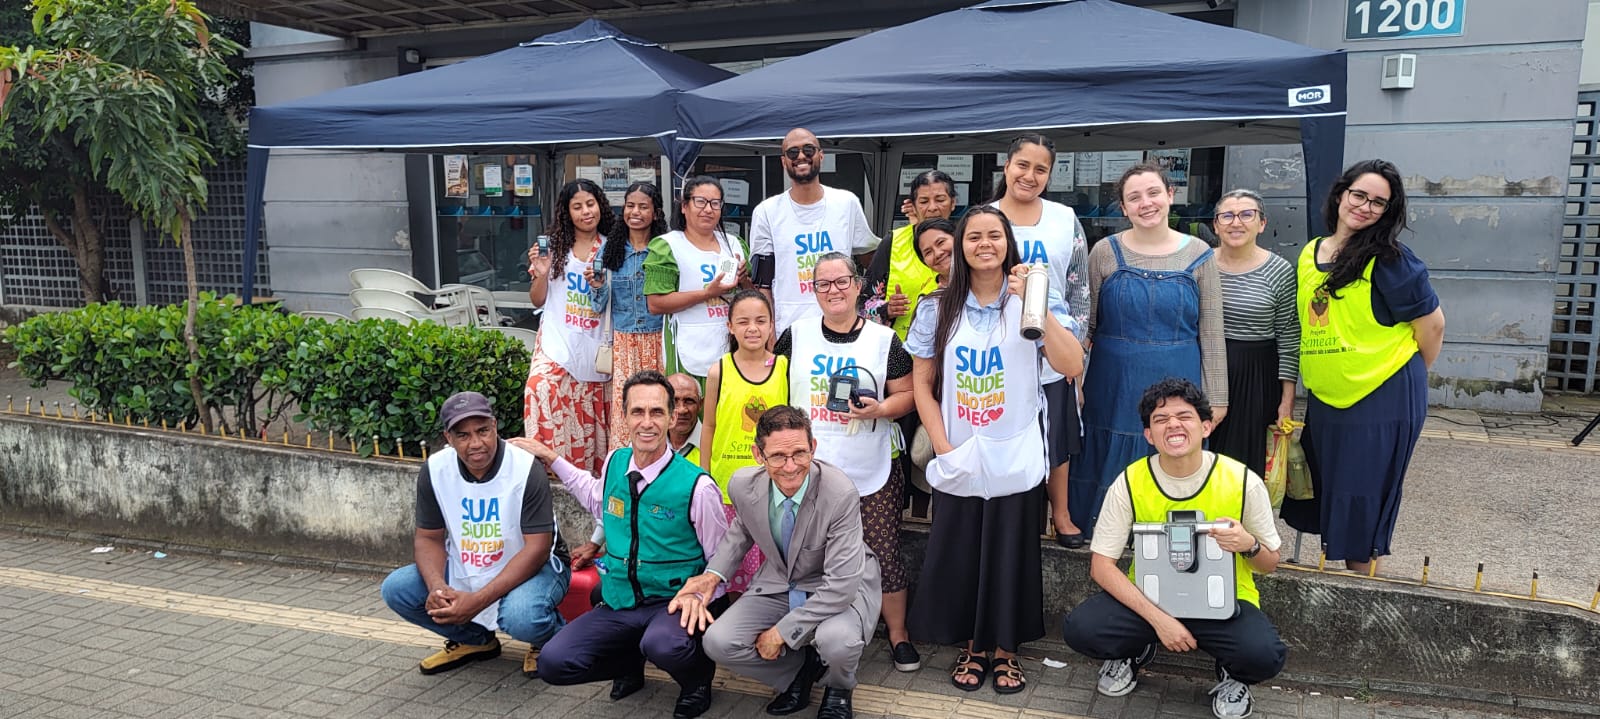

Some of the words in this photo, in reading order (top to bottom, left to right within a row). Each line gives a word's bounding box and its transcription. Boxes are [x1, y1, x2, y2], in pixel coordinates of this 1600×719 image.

[1355, 0, 1456, 34] 1200
[1298, 91, 1322, 101] MOR
[795, 231, 834, 255] SUA
[567, 271, 591, 294] SU
[810, 353, 859, 379] SUA
[955, 345, 1004, 377] SUA
[979, 390, 1005, 411] TEM
[461, 497, 500, 523] SUA
[480, 539, 505, 554] TEM
